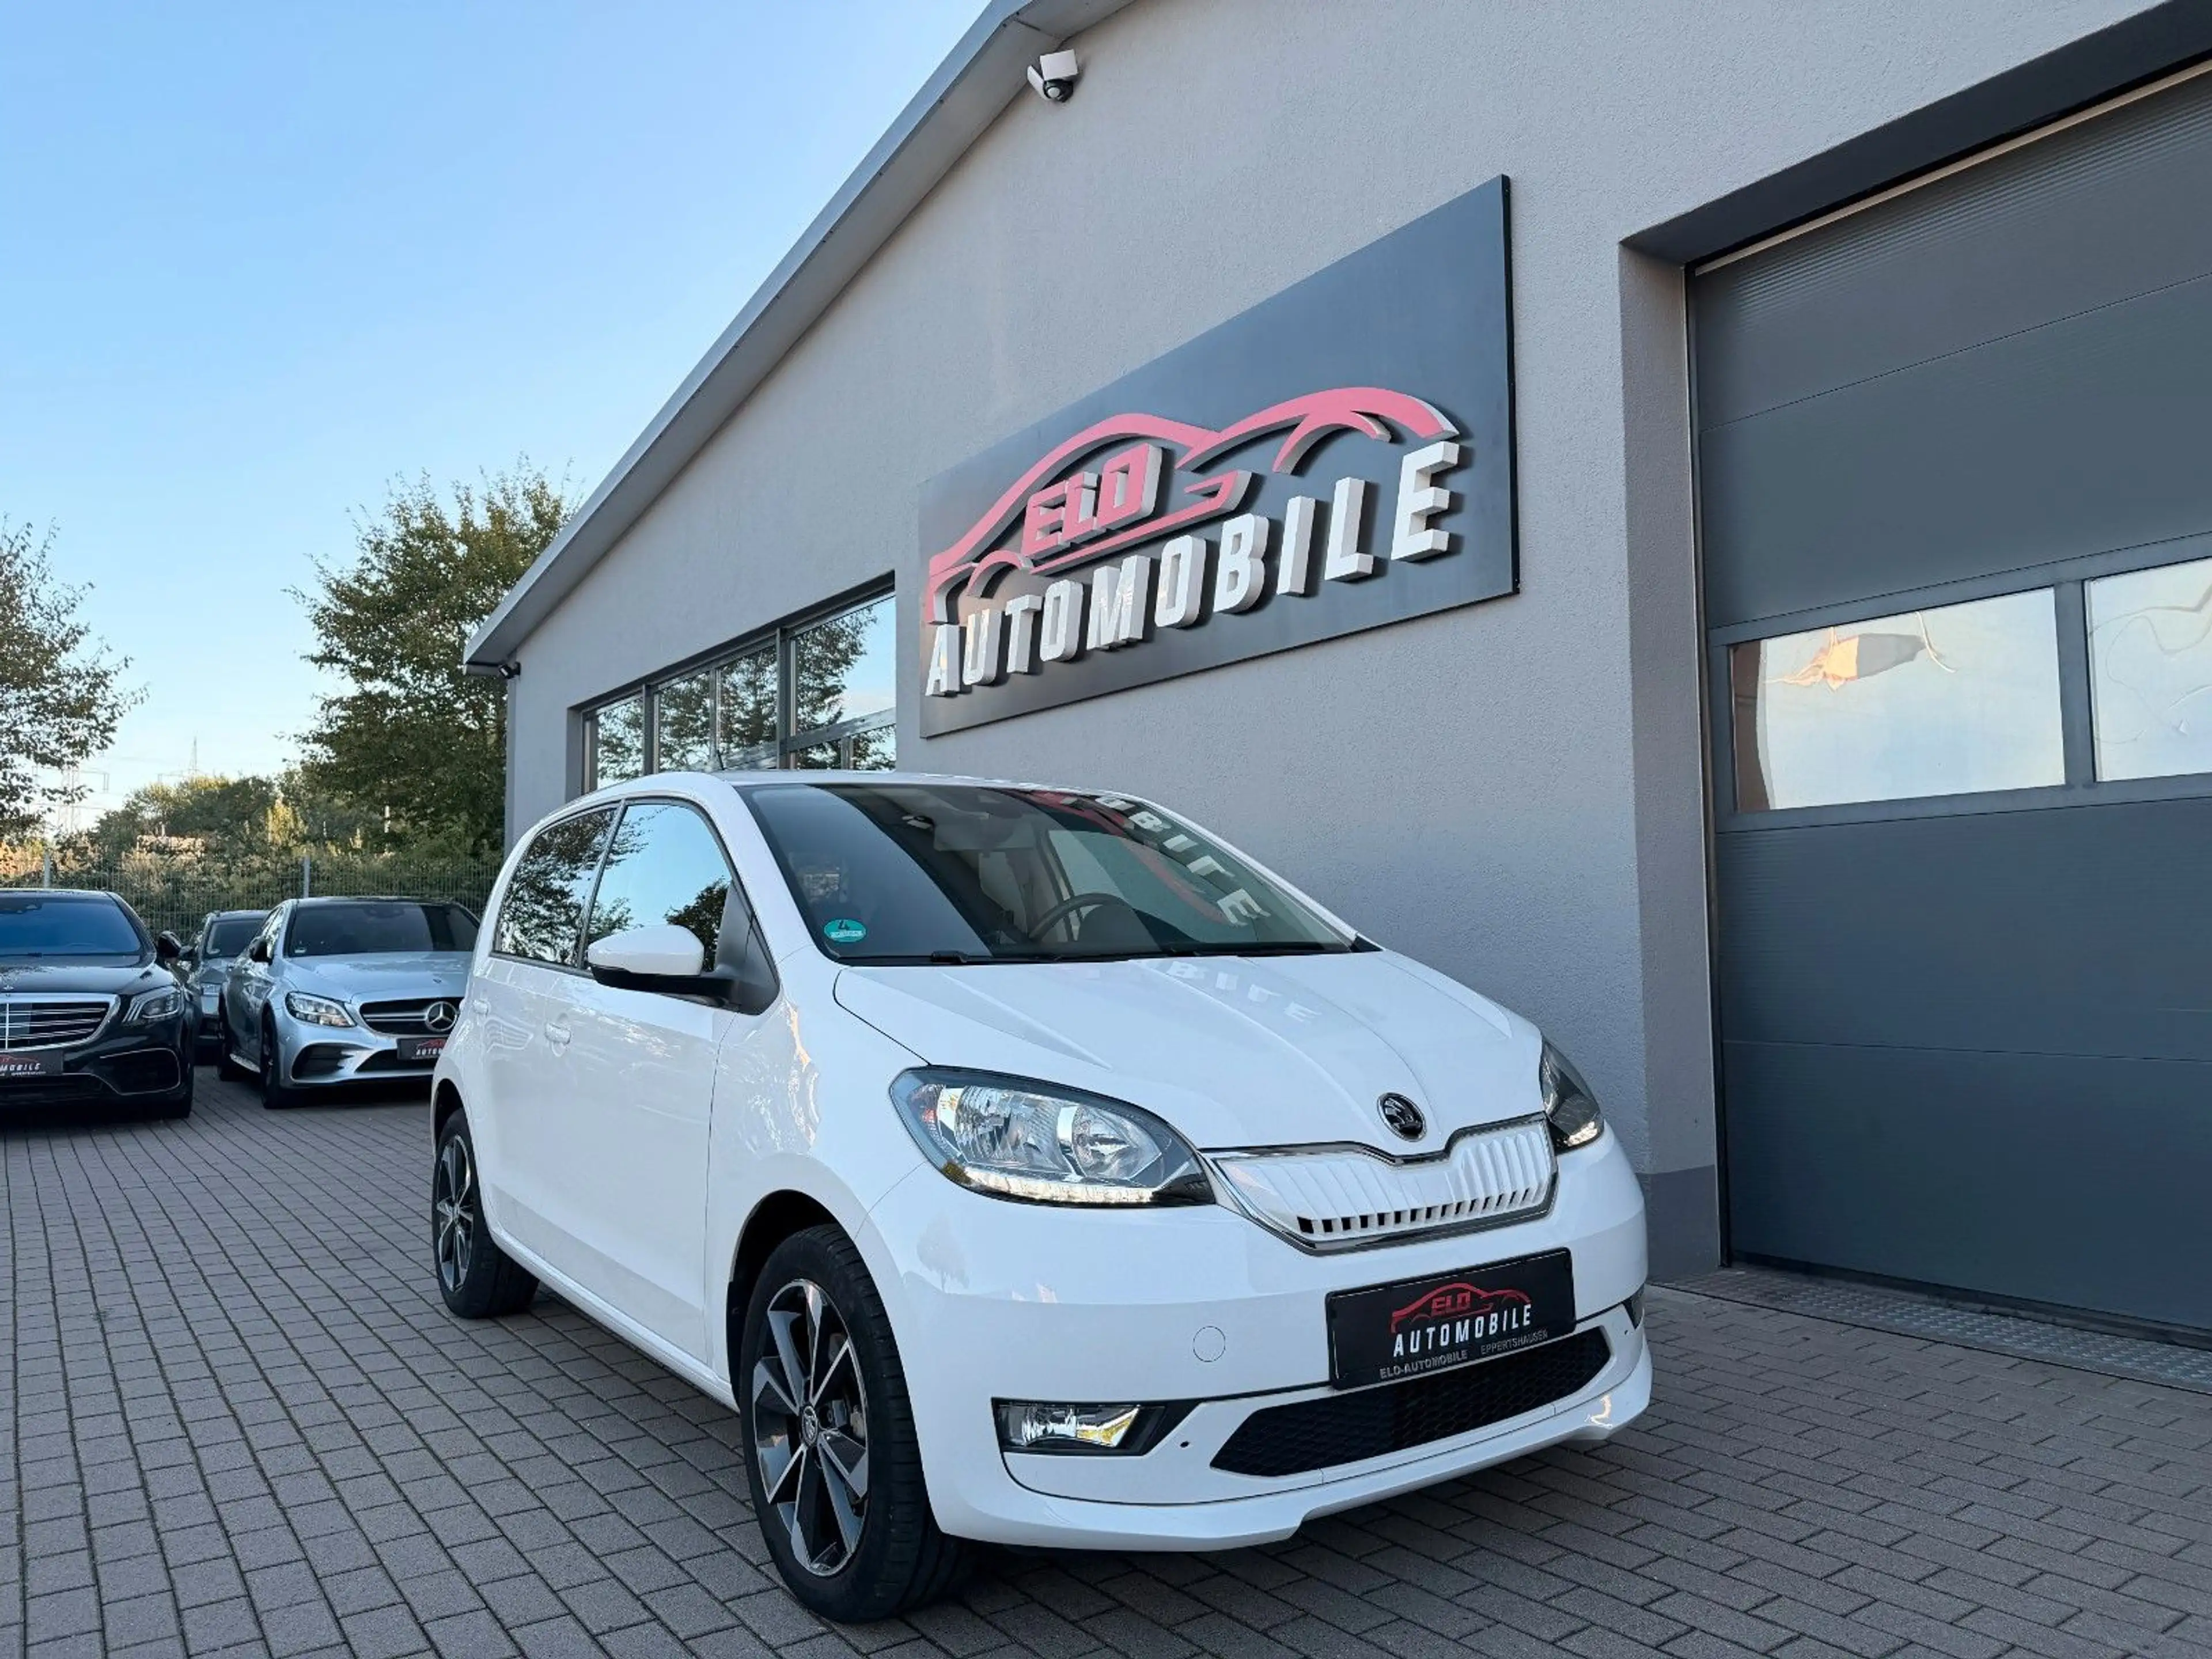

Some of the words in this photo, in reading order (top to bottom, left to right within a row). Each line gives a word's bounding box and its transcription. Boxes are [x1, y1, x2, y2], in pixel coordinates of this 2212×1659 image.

[1021, 442, 1162, 559] ELO
[925, 441, 1459, 696] AUTOMOBILE
[1393, 1304, 1532, 1357] AUTOMOBILE
[1431, 1291, 1471, 1317] ELO
[1380, 1350, 1468, 1379] ELO-AUTOMOBILE
